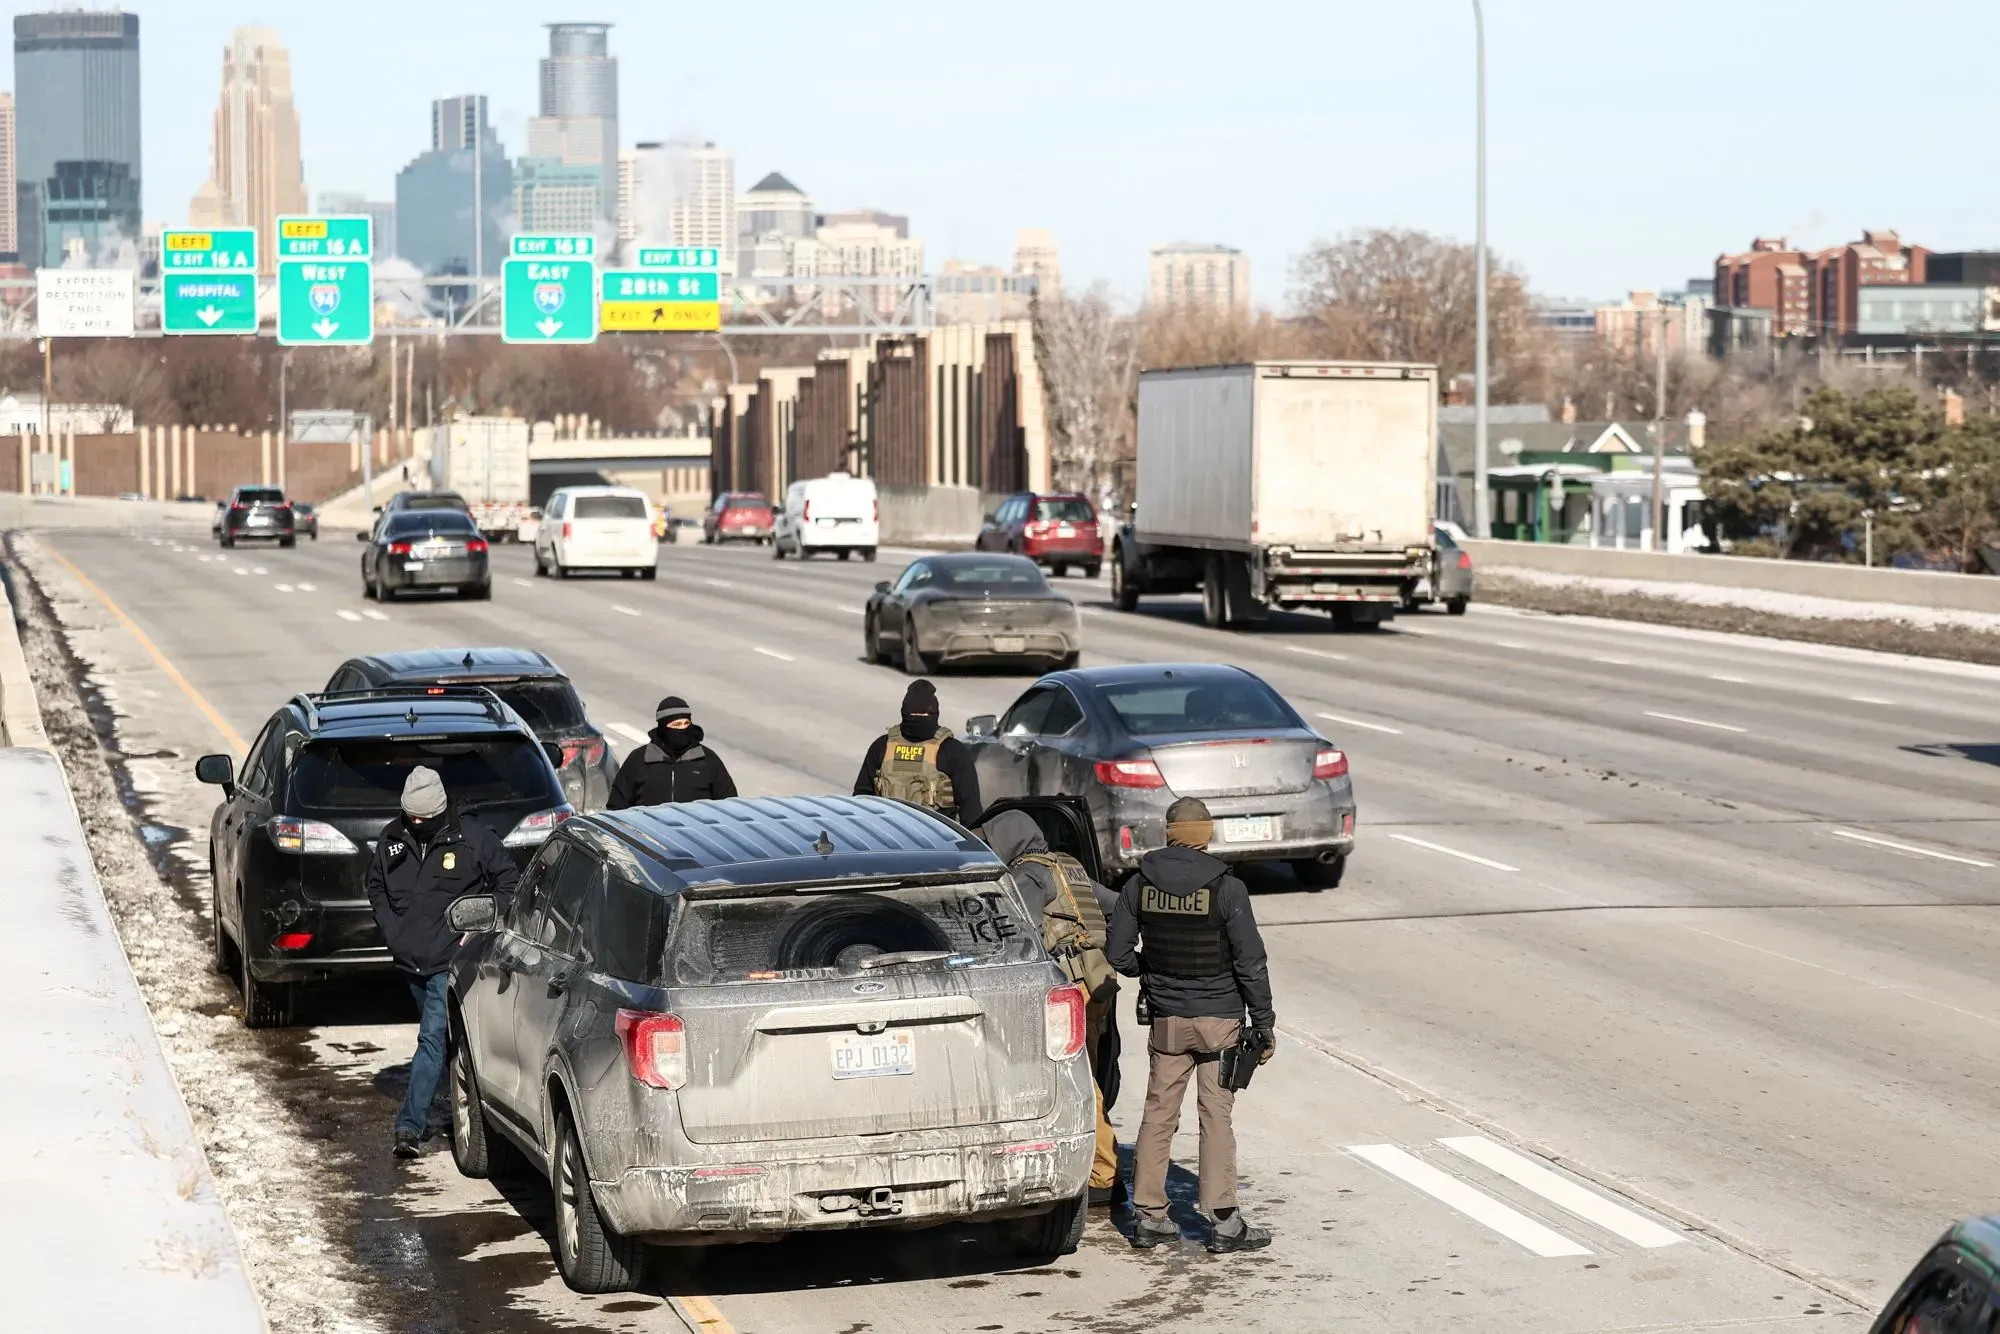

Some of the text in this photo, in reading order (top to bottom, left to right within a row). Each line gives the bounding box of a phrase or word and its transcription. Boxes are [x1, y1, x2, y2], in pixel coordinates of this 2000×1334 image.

[287, 225, 321, 236] LEFT
[172, 237, 206, 248] LEFT
[289, 239, 363, 255] EXIT 16 A
[172, 251, 248, 267] EXIT 16 A
[179, 284, 241, 298] HOSPITAL
[677, 277, 700, 295] St
[315, 292, 334, 307] 94
[896, 746, 923, 755] POLICE
[940, 892, 1002, 918] NOT
[1147, 889, 1203, 911] POLICE
[968, 915, 1016, 942] ICE
[836, 1045, 908, 1068] EPJ 0132
